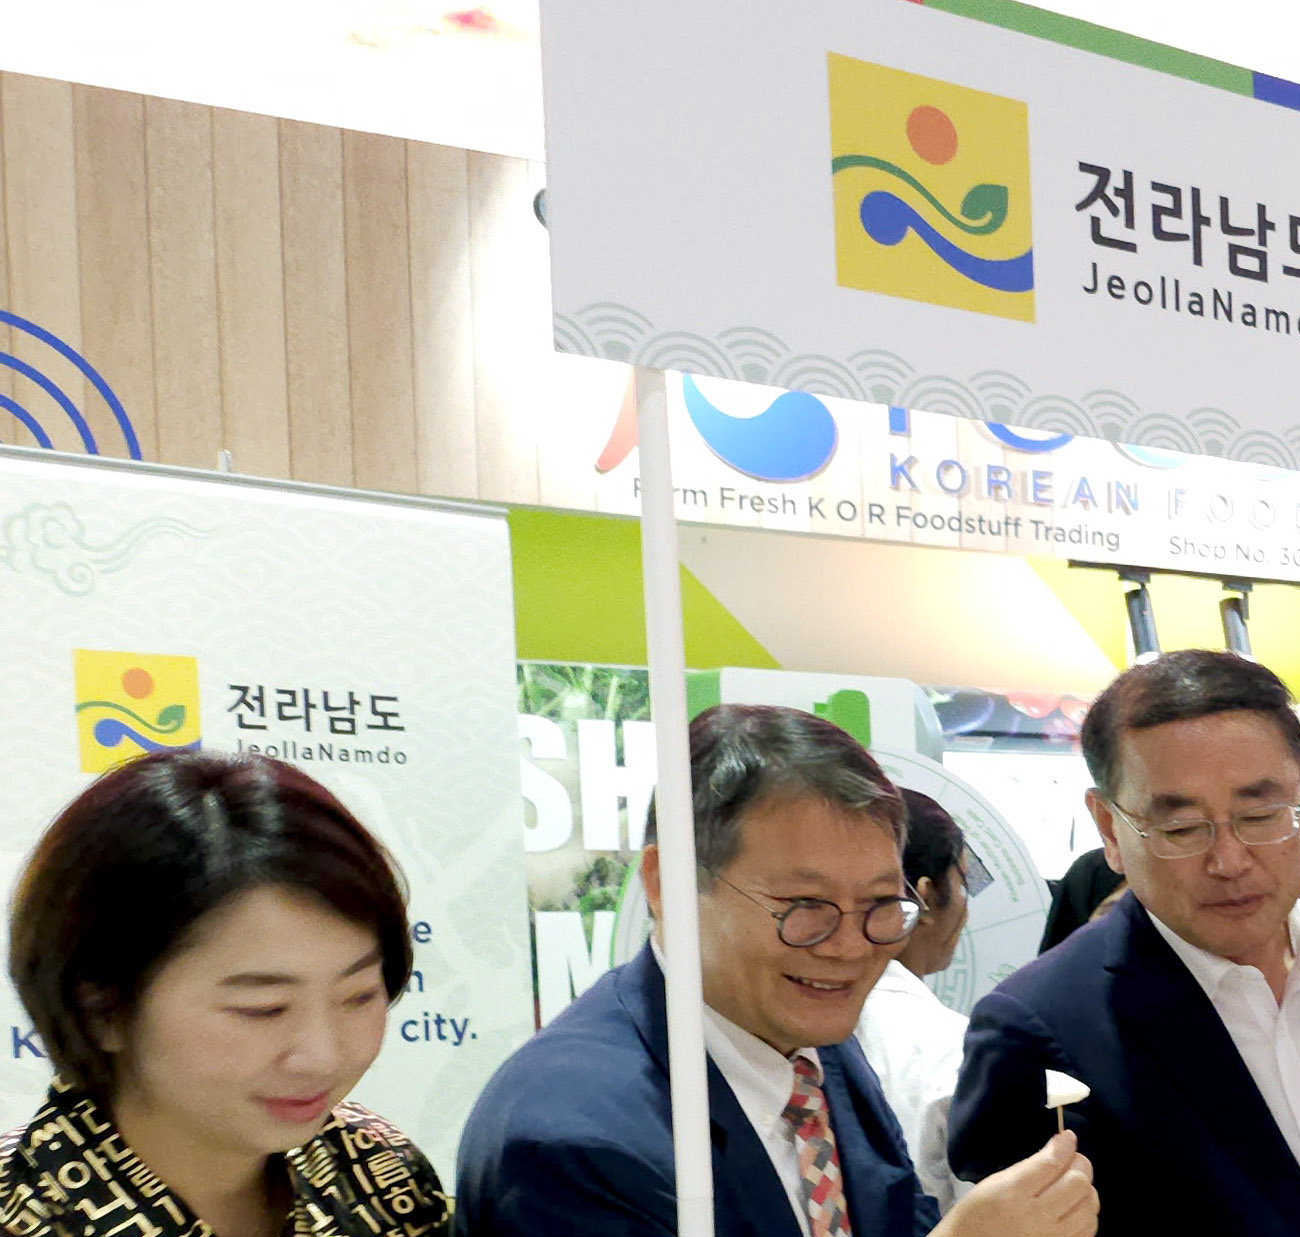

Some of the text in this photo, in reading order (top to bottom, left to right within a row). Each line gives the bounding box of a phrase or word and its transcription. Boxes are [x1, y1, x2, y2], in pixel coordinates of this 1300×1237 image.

[889, 452, 1140, 515] KOREAN
[720, 486, 797, 516] Fresh
[896, 505, 1024, 538] Foodstuff
[1030, 519, 1121, 552] Trading
[1169, 535, 1226, 560] Shop
[1236, 544, 1271, 564] No.
[227, 684, 406, 735] 전라남도
[401, 1011, 478, 1046] city.
